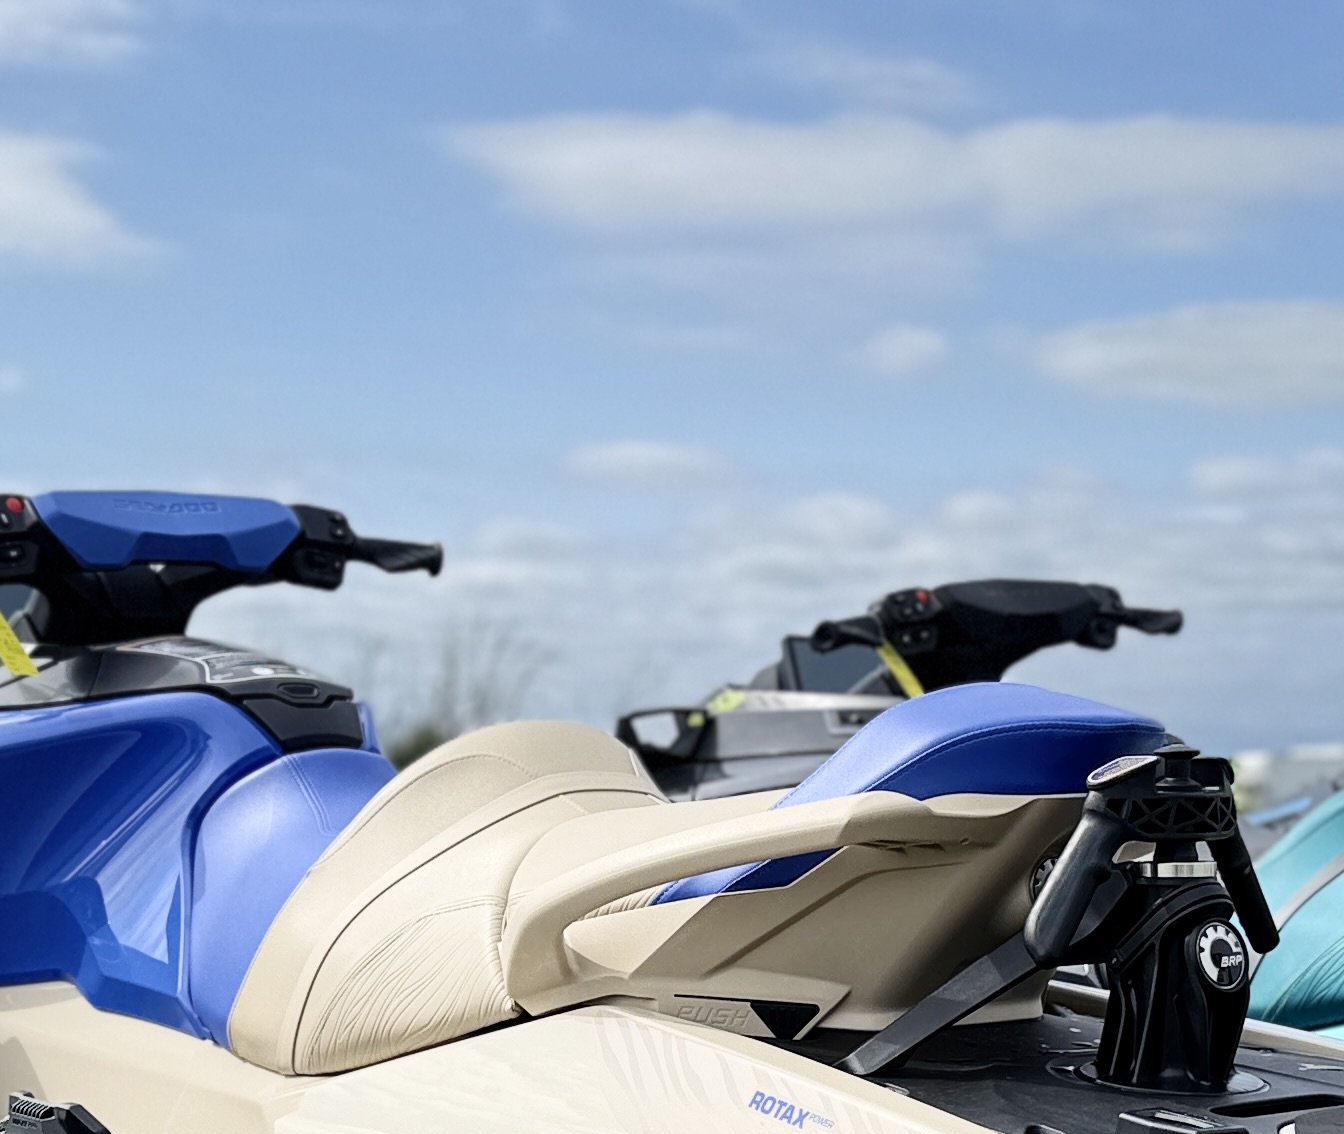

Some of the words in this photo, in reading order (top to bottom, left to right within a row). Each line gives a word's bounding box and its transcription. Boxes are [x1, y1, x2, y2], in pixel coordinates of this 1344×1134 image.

[1220, 954, 1244, 968] BRP
[748, 1090, 810, 1129] ROTAX
[808, 1112, 835, 1129] POWER
